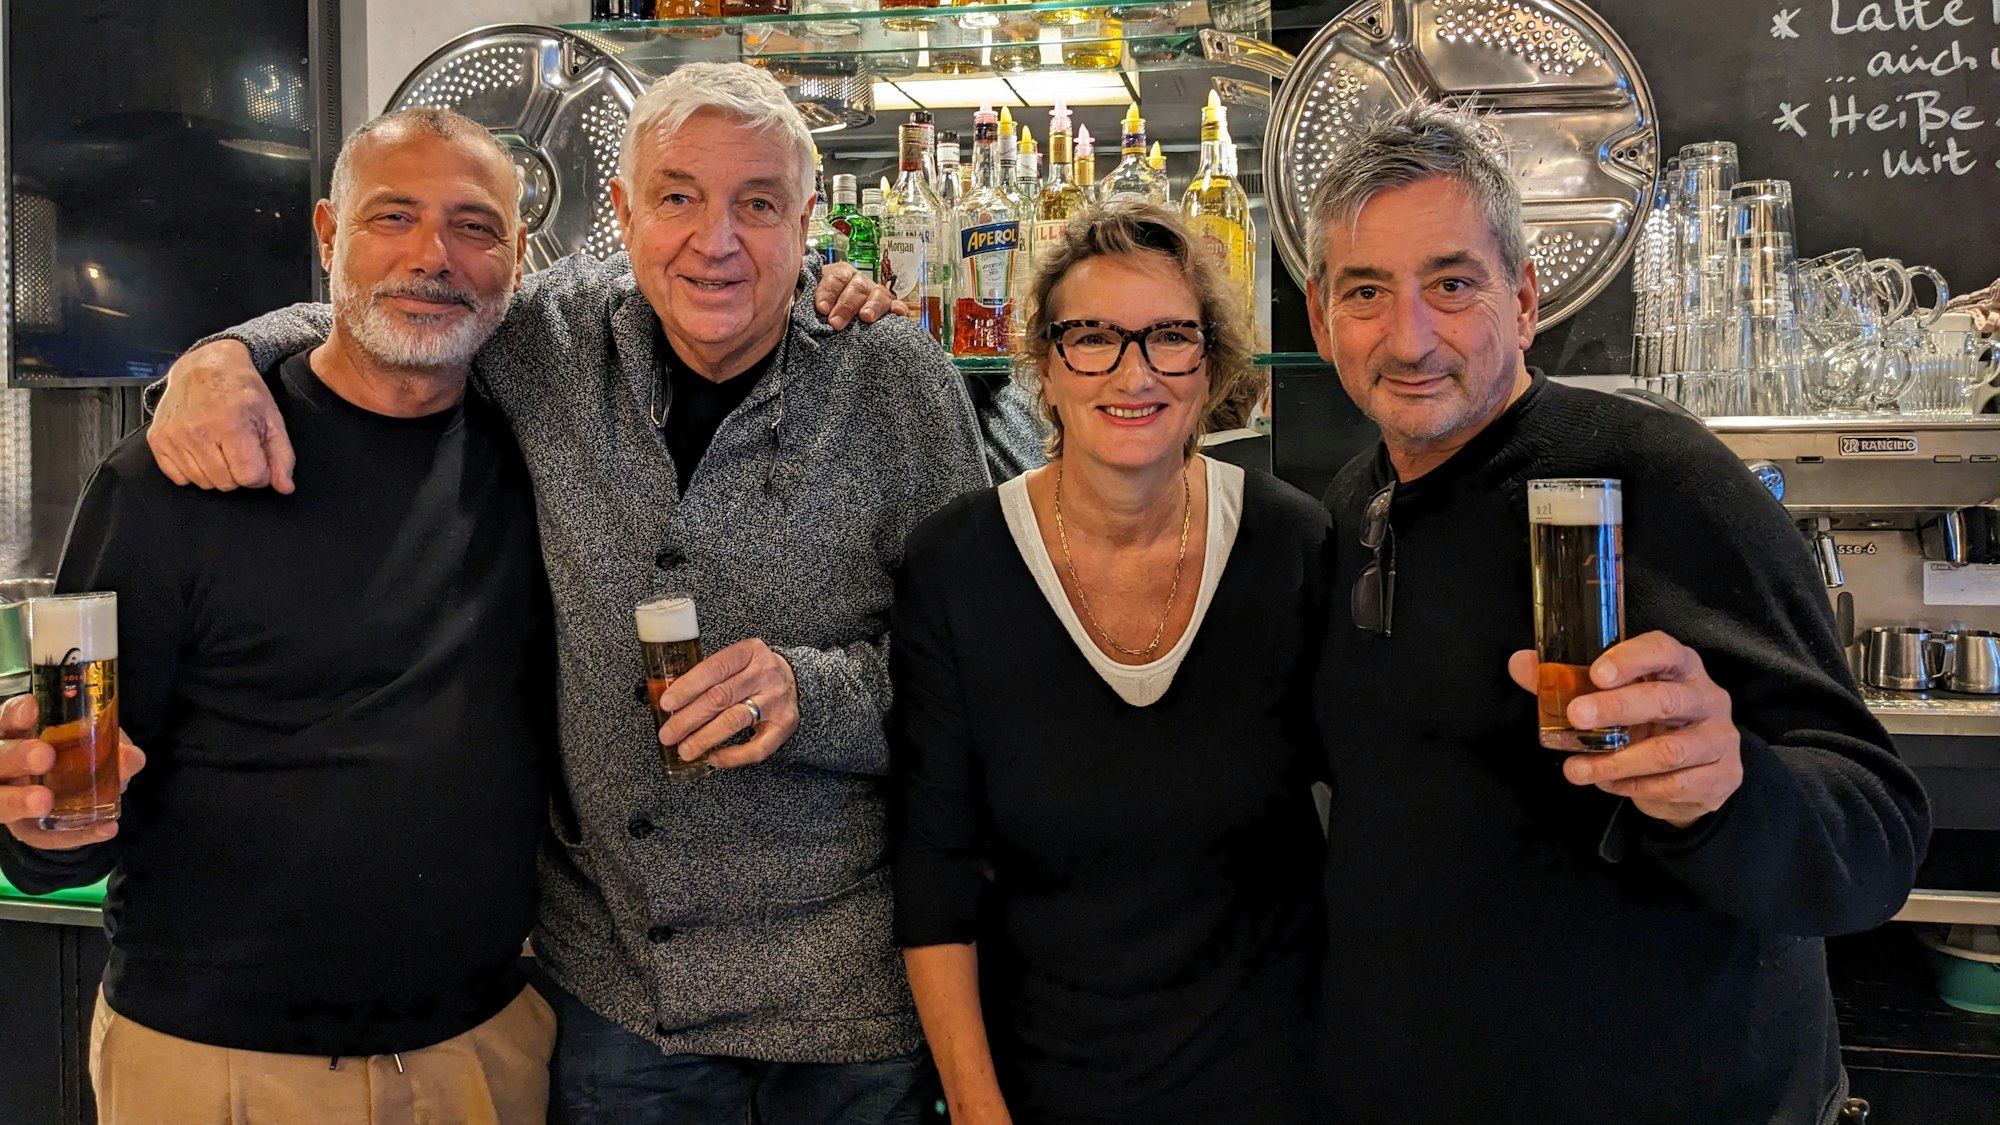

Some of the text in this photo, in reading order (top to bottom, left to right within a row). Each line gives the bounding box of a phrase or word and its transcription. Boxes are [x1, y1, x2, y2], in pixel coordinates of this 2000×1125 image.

[1831, 0, 1974, 34] Latte
[1829, 90, 1984, 145] Heiße
[887, 240, 915, 254] Morgan
[967, 228, 1016, 253] APEROL
[1861, 440, 1917, 451] RANCILIO
[1836, 543, 1876, 554] sse-6
